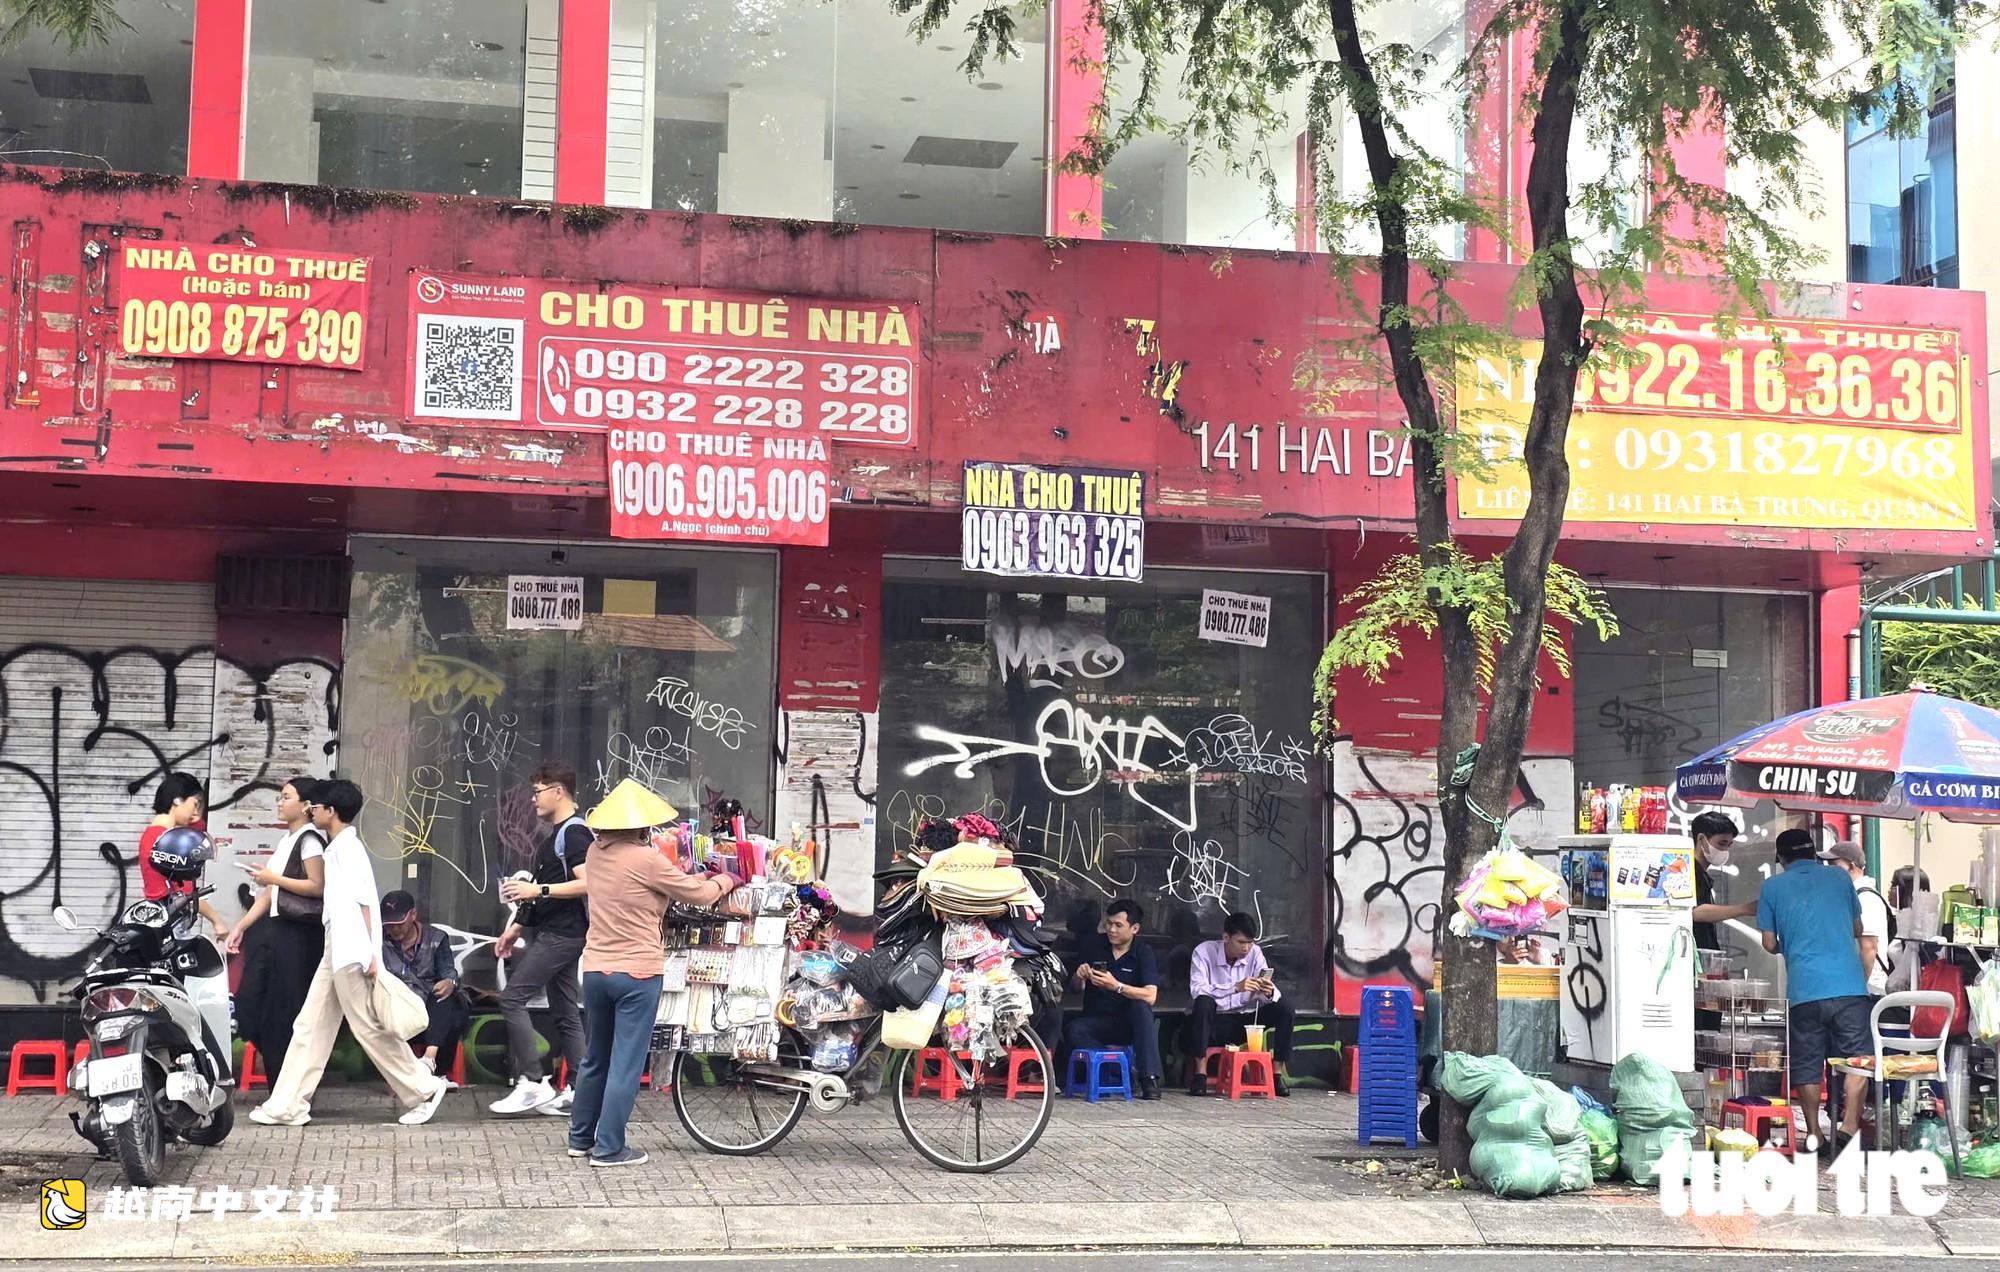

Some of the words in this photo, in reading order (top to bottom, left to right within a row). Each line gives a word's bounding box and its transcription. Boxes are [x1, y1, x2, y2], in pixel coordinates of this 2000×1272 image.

[126, 246, 195, 272] NHÀ
[207, 252, 275, 277] CHO
[286, 256, 367, 283] THUÊ
[182, 275, 251, 297] (Hoặc
[258, 279, 311, 301] bán)
[451, 284, 492, 295] SUNNY
[493, 286, 525, 297] LAND
[123, 298, 212, 354] 0908
[223, 303, 288, 360] 875
[297, 308, 362, 365] 399
[540, 291, 644, 330] CHO
[662, 296, 792, 340] THUÊ
[807, 306, 912, 346] NHÀ
[1819, 323, 1941, 353] THUÊ
[574, 347, 667, 383] 090
[683, 354, 804, 391] 2222
[820, 362, 907, 396] 328
[573, 387, 697, 423] 0932
[713, 393, 803, 429] 228
[819, 402, 907, 434] 228
[609, 430, 667, 454] CHO
[676, 430, 751, 457] THUÊ
[763, 436, 827, 461] NHÀ
[1192, 420, 1260, 471] 141
[1278, 423, 1350, 475] HAI
[1615, 427, 1957, 479] 0931827968
[613, 459, 827, 524] 0906.905.006
[966, 465, 1015, 507] NHÀ
[1023, 472, 1074, 510] CHO
[1081, 471, 1143, 516] THUÊ
[1607, 493, 1642, 512] 141
[1656, 494, 1700, 515] HAI
[1711, 488, 1746, 516] BÀ
[661, 521, 702, 534] A.Ngọc
[965, 509, 1029, 569] 0903
[1037, 510, 1086, 576] 963
[1094, 517, 1140, 578] 325
[514, 582, 532, 592] CHO
[535, 580, 558, 593] THUÊ
[561, 580, 579, 593] NHÀ
[512, 596, 580, 620] 0908.777.488
[1208, 595, 1226, 607] CHO
[1228, 598, 1249, 610] THUÊ
[1250, 600, 1267, 613] NHÀ
[1205, 609, 1267, 638] 0908.777.488
[1814, 716, 1896, 730] CHIN-SU
[1815, 725, 1874, 735] GLOBAL
[1759, 766, 1857, 796] CHIN-SU
[1909, 780, 1933, 797] CÁ
[1935, 782, 1977, 798] CƠM
